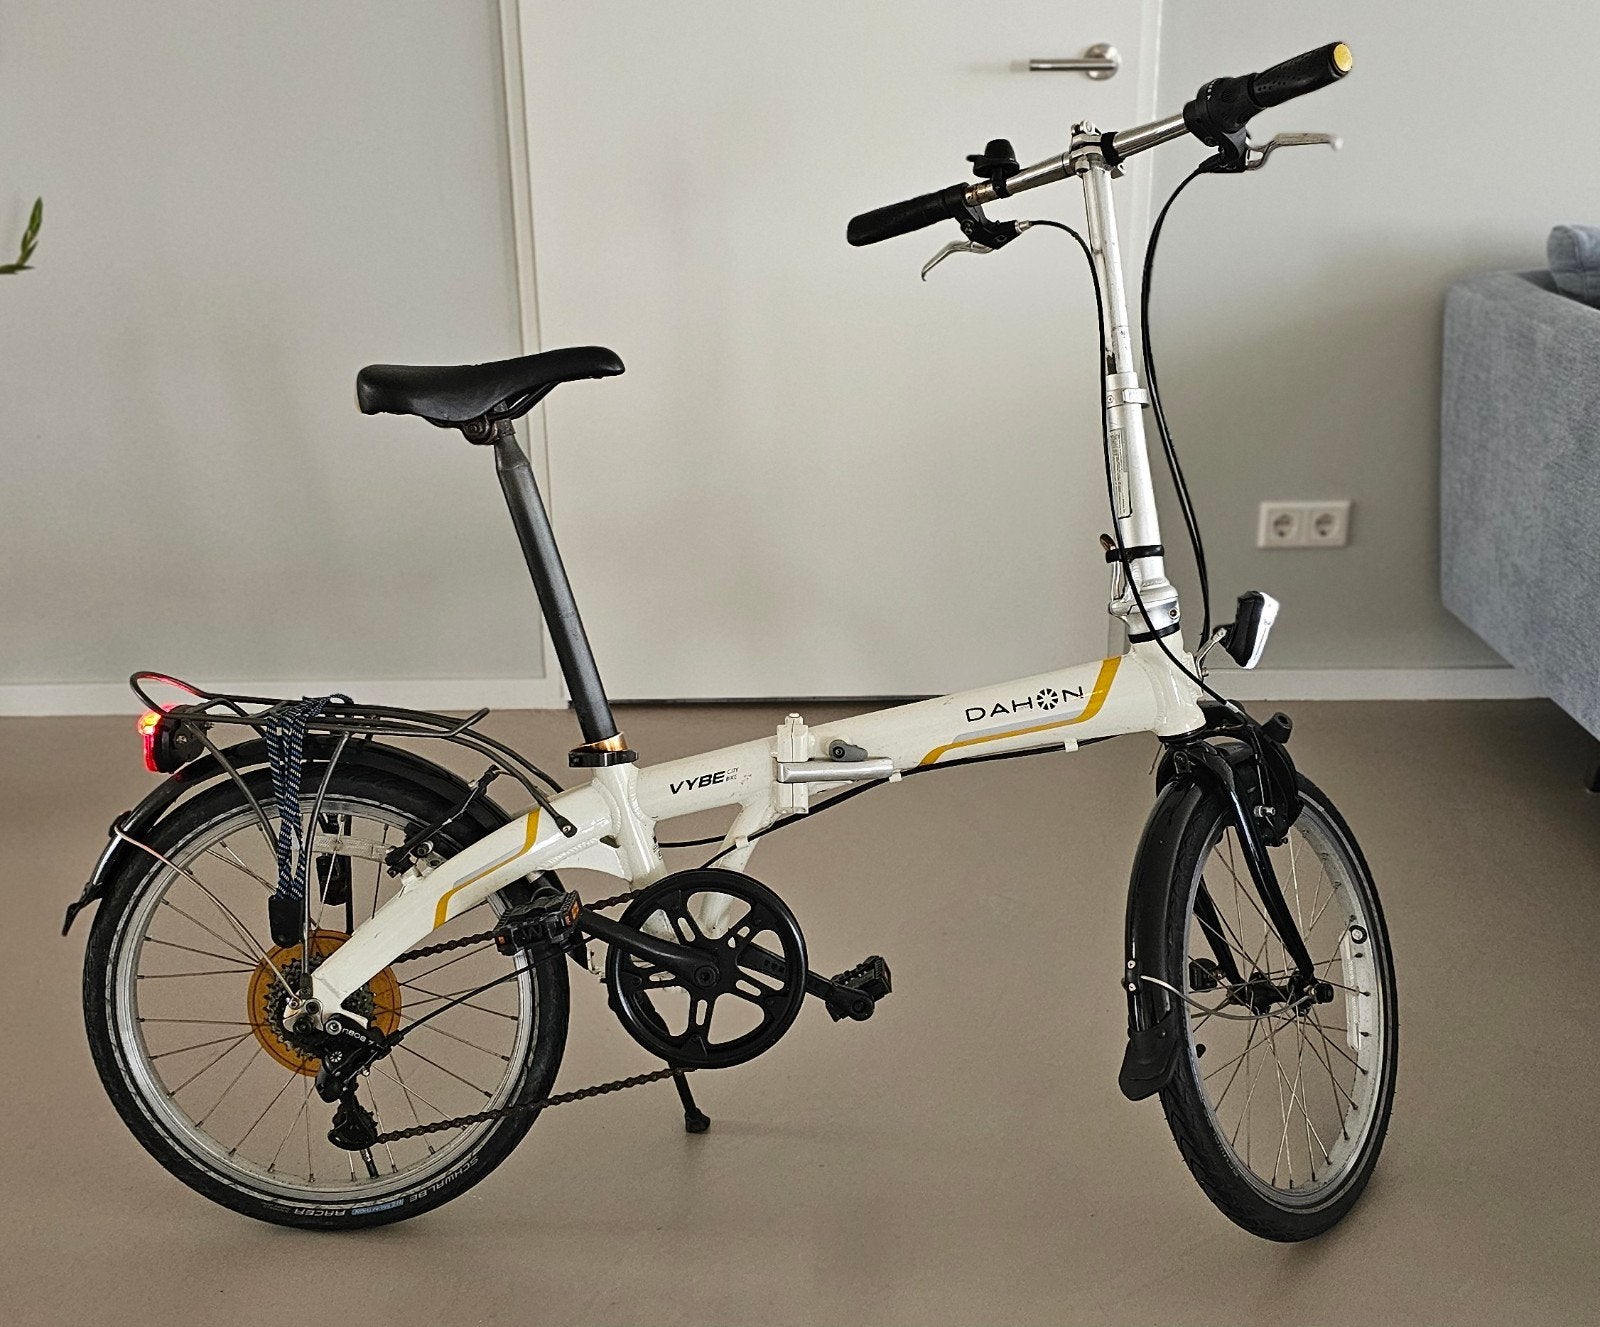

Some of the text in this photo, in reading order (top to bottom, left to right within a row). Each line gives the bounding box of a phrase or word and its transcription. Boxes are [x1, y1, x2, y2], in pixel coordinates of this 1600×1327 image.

[965, 686, 1084, 722] DAHON
[669, 770, 726, 795] VYBE
[409, 1155, 479, 1203] SCHWALBE
[294, 1208, 346, 1217] RACER
